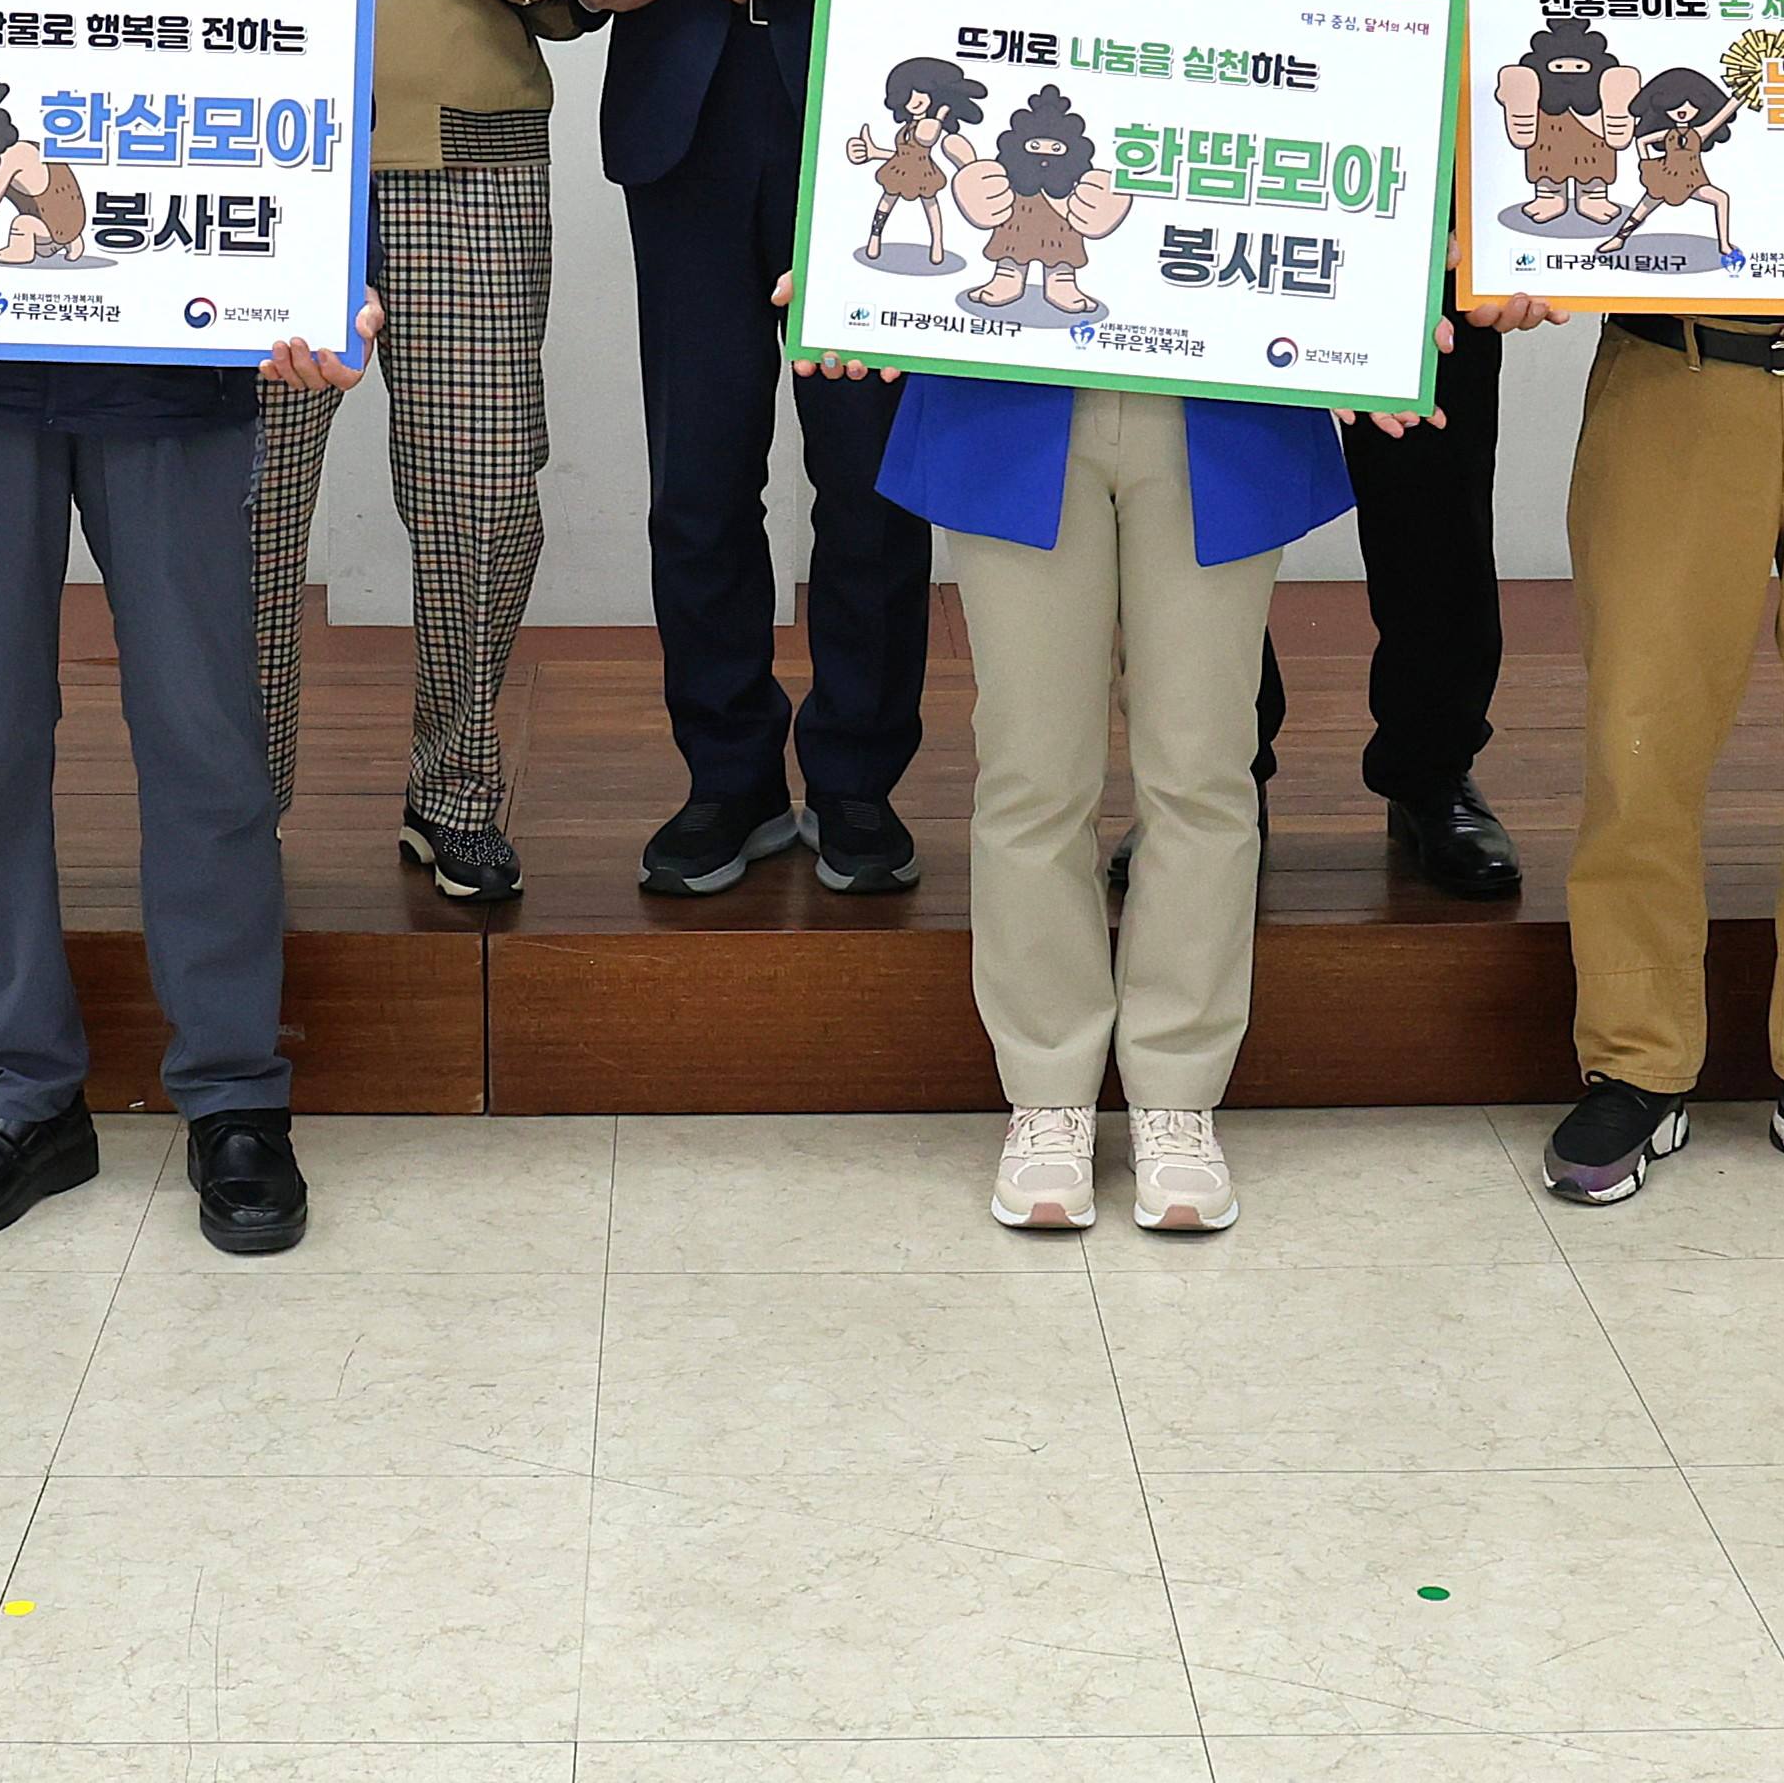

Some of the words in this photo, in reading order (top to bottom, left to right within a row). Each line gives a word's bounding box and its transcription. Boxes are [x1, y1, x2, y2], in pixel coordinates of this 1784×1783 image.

[87, 14, 189, 49] 행복을
[202, 17, 305, 52] 전하는
[1301, 13, 1325, 26] 대구
[1332, 15, 1359, 31] 중심,
[1365, 18, 1399, 32] 달서의
[1405, 22, 1429, 35] 시대
[956, 27, 1057, 65] 뜨개로
[1071, 37, 1174, 79] 나눔을
[1184, 47, 1317, 89] 실천하는
[40, 90, 341, 173] 한삽모아
[1112, 123, 1406, 220] 한땀모아
[92, 192, 282, 257] 봉사단
[1158, 225, 1344, 299] 봉사단
[1547, 255, 1630, 270] 대구광역시
[1635, 256, 1686, 271] 달서구
[14, 293, 60, 302] 사회복지법인
[65, 295, 102, 303] 가정복지회
[11, 303, 121, 322] 두류은빛복지관
[225, 308, 289, 322] 보건복지부
[881, 311, 964, 333] 대구광역시
[971, 318, 1022, 337] 달서구
[1097, 329, 1205, 357] 두류은빛복지관
[1099, 323, 1146, 337] 사회복지법인
[1150, 327, 1188, 337] 가정복지회
[1305, 349, 1368, 366] 보건복지부
